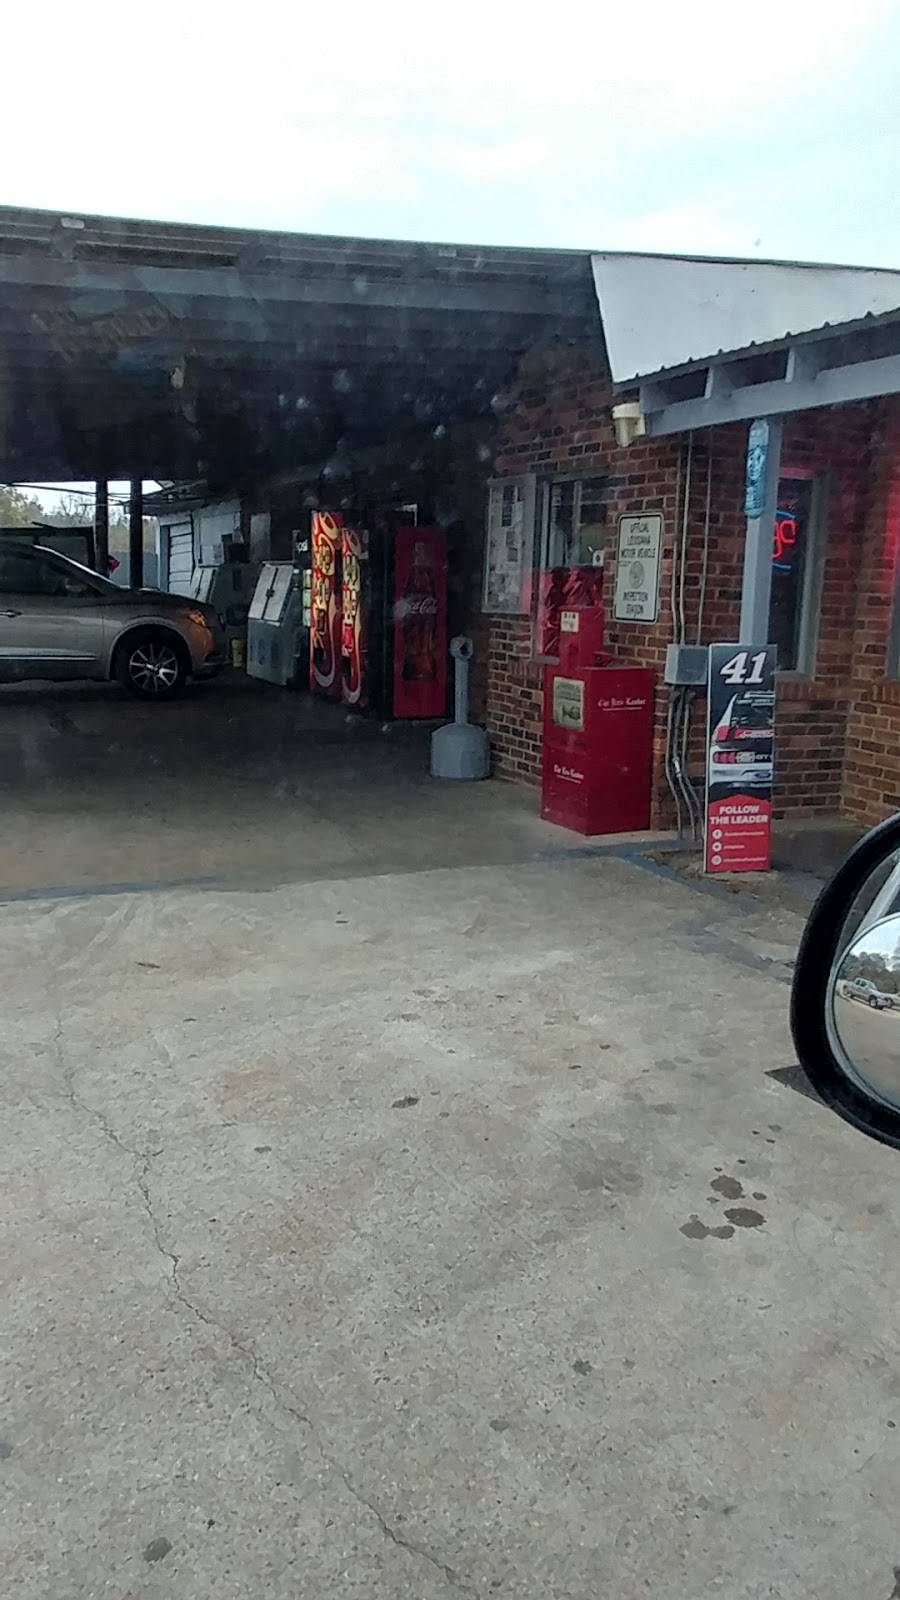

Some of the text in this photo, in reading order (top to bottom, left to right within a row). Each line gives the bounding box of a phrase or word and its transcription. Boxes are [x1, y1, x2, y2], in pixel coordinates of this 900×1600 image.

[719, 651, 768, 685] 41
[719, 804, 760, 815] FOLLOW
[709, 814, 769, 825] THE LEADER
